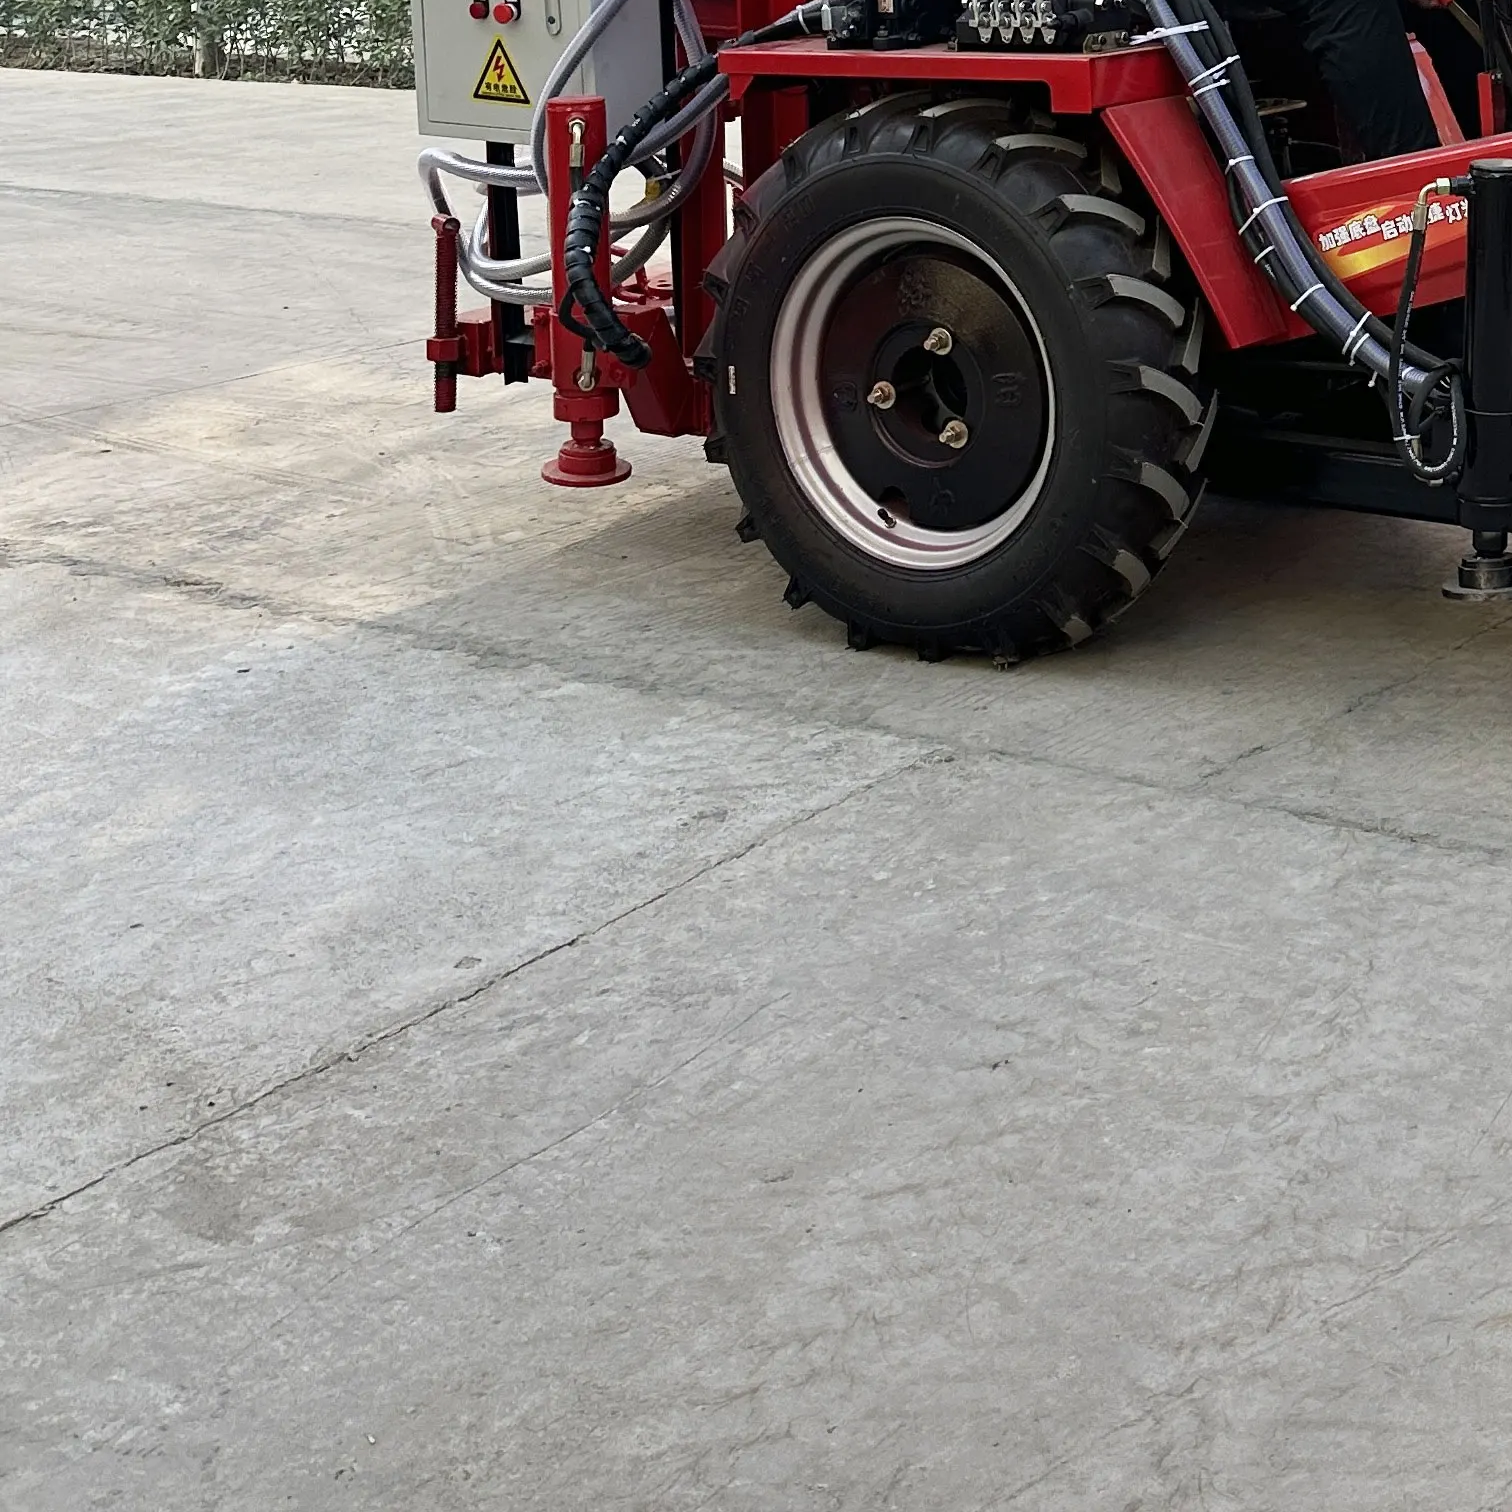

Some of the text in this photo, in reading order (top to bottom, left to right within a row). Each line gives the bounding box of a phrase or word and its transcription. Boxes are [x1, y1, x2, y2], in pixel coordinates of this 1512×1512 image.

[484, 81, 517, 94] 有电危险
[1317, 213, 1382, 252] 加强底盘
[1380, 201, 1445, 241] 启动捷
